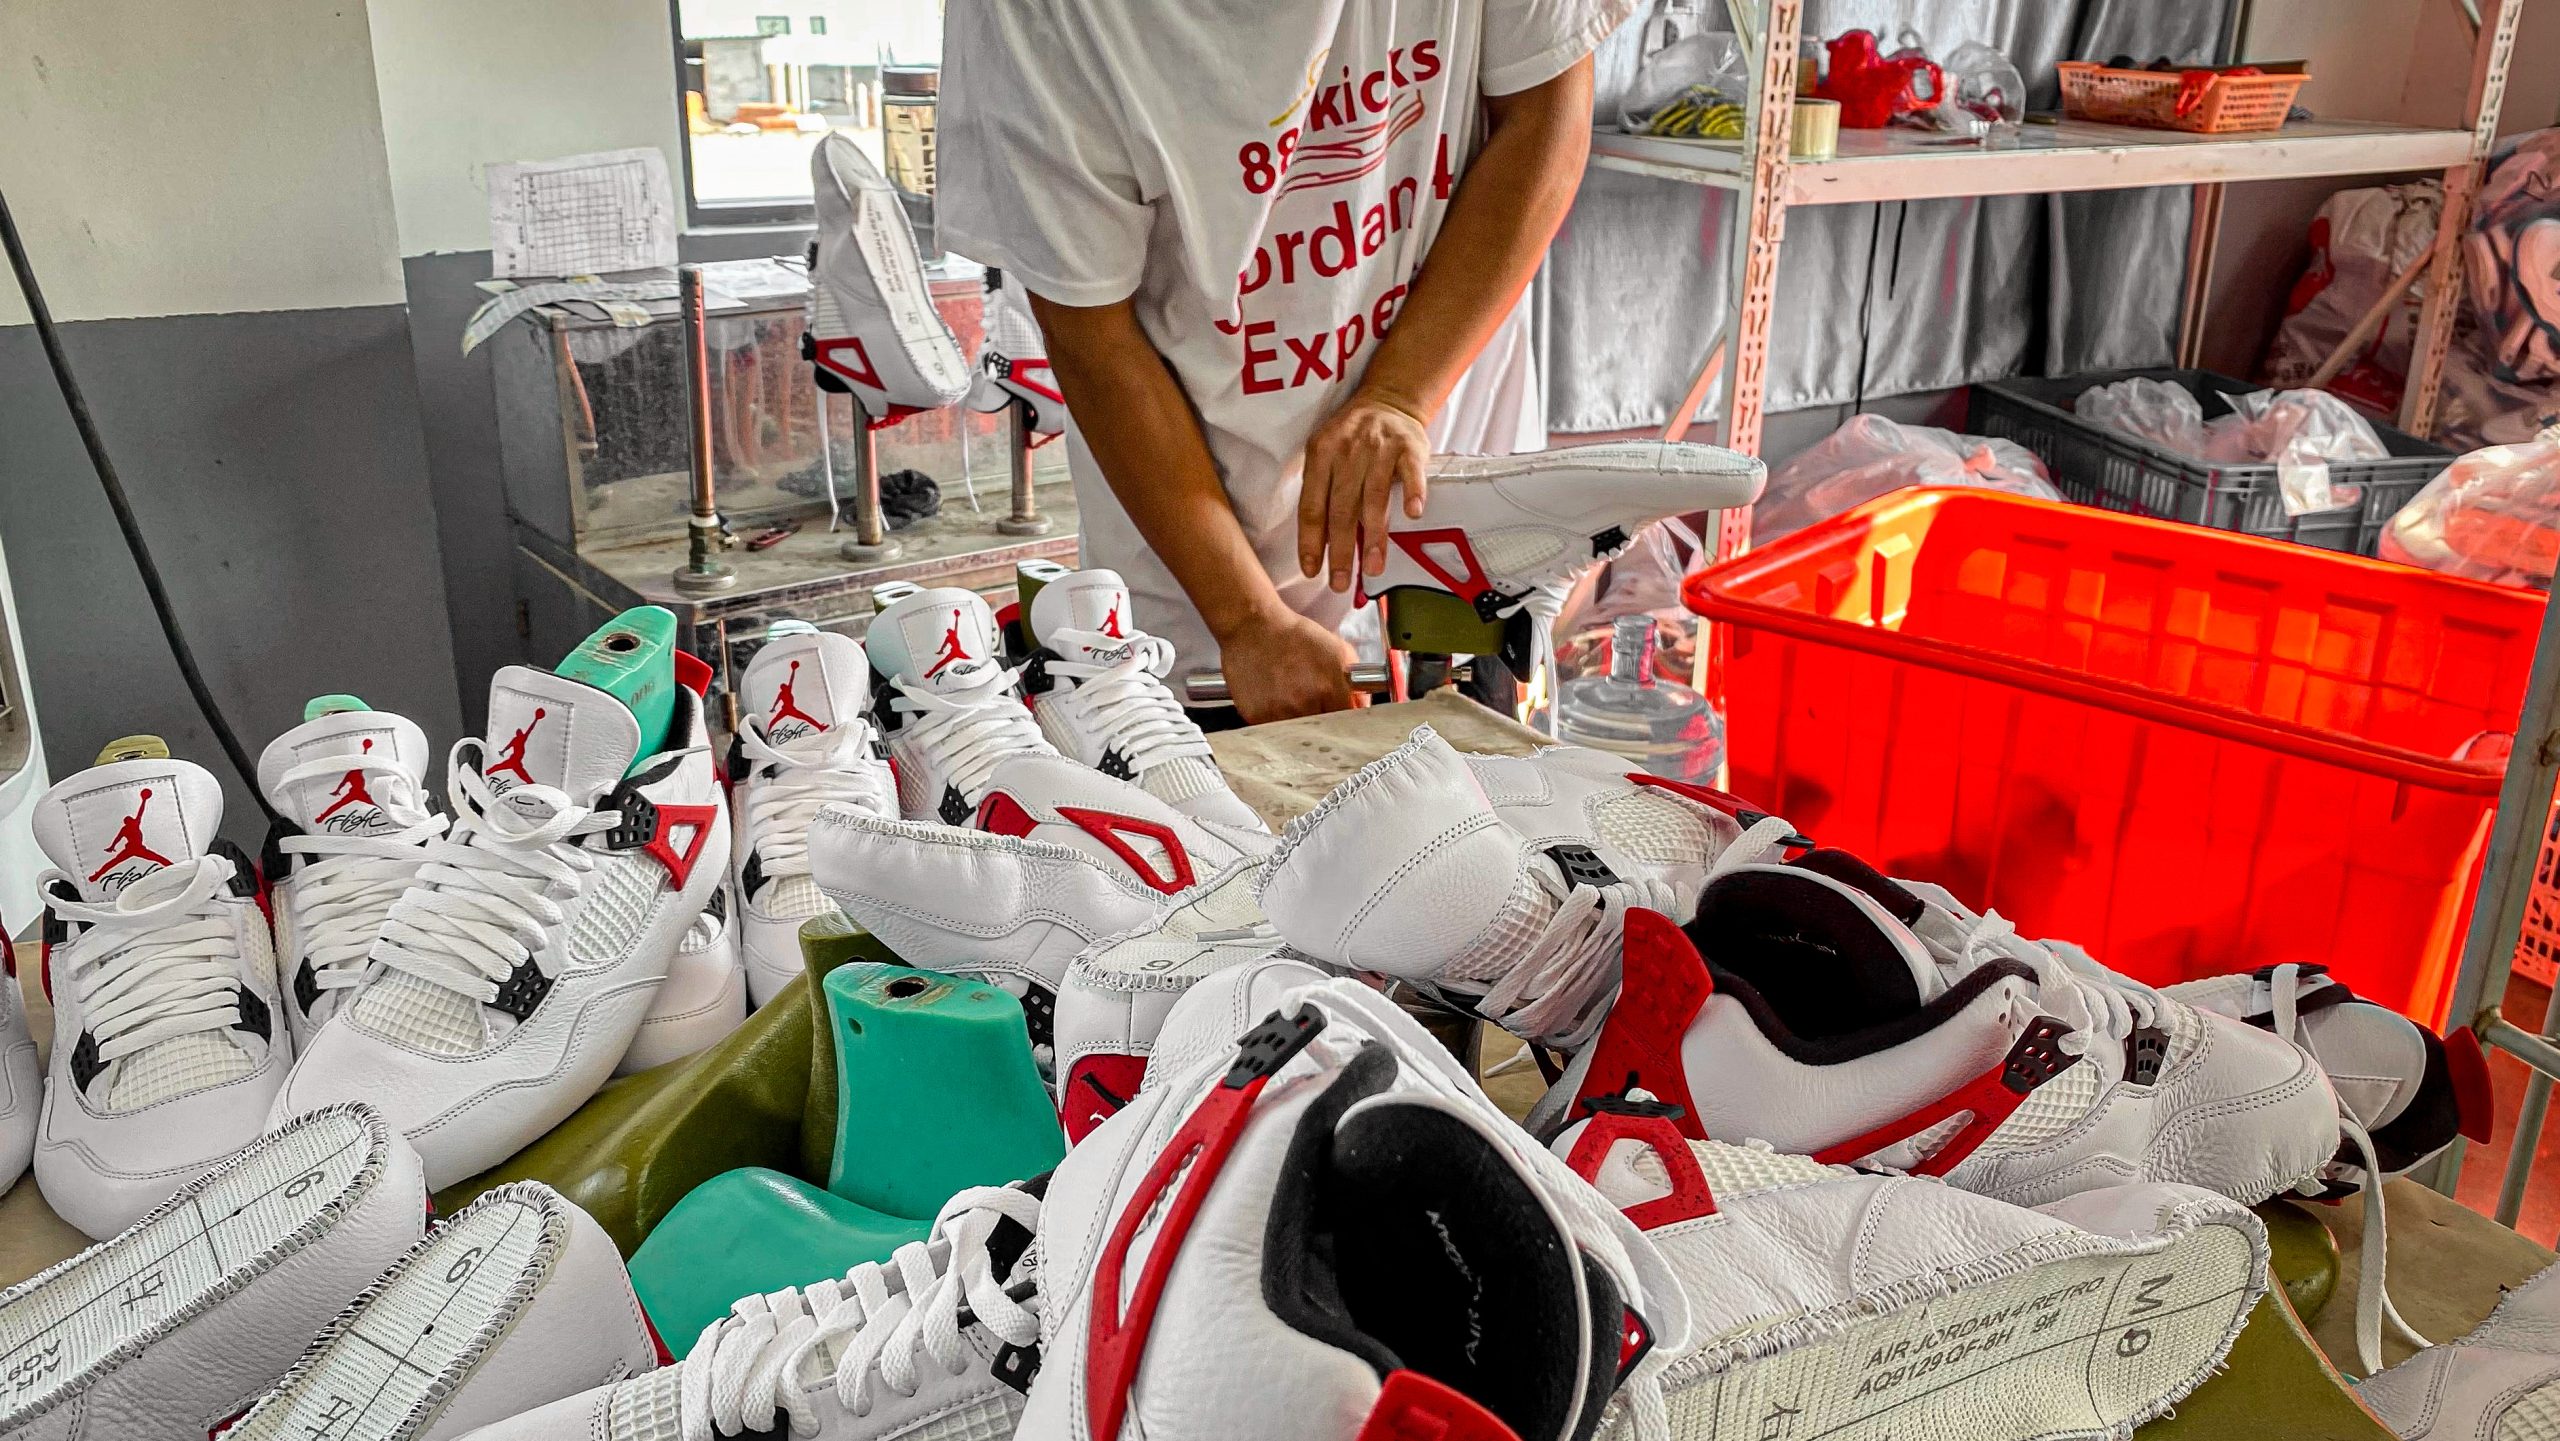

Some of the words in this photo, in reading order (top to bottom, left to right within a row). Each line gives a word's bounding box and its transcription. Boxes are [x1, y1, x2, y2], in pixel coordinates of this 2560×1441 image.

[324, 807, 389, 833] Flight
[1862, 1338, 1911, 1371] AIR
[1912, 1307, 2011, 1355] JORDAN
[2010, 1301, 2027, 1319] 4
[2026, 1276, 2106, 1315] RETRO
[5, 1339, 62, 1383] AQ9
